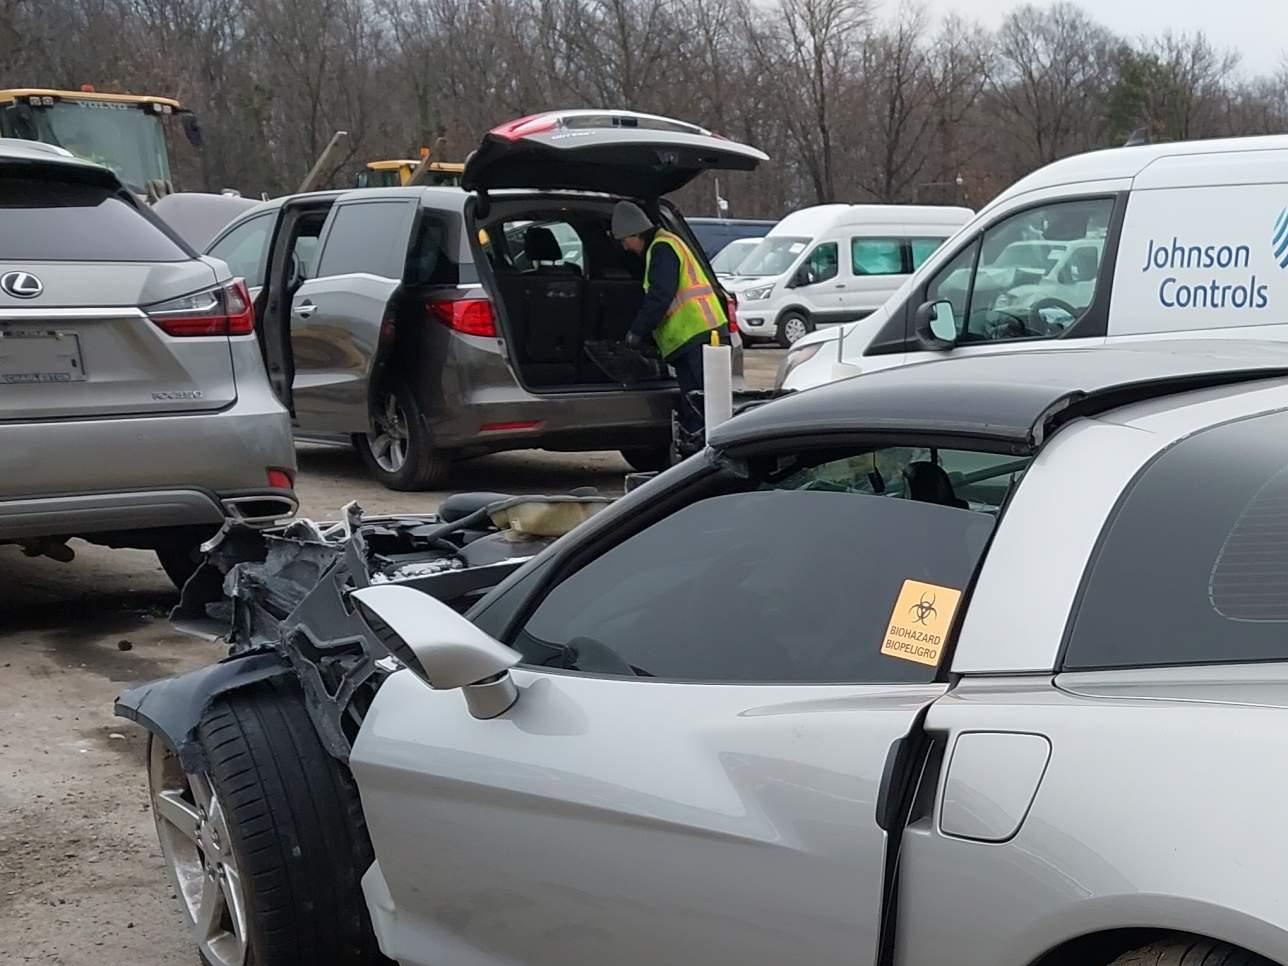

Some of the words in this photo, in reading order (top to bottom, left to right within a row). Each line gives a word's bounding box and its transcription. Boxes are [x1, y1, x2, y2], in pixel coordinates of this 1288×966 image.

[78, 101, 128, 110] VOLVO
[1142, 237, 1250, 272] Johnson
[1159, 275, 1268, 309] Controls
[890, 625, 941, 645] BIOHAZARD
[885, 639, 937, 659] BIOPELIGRO
